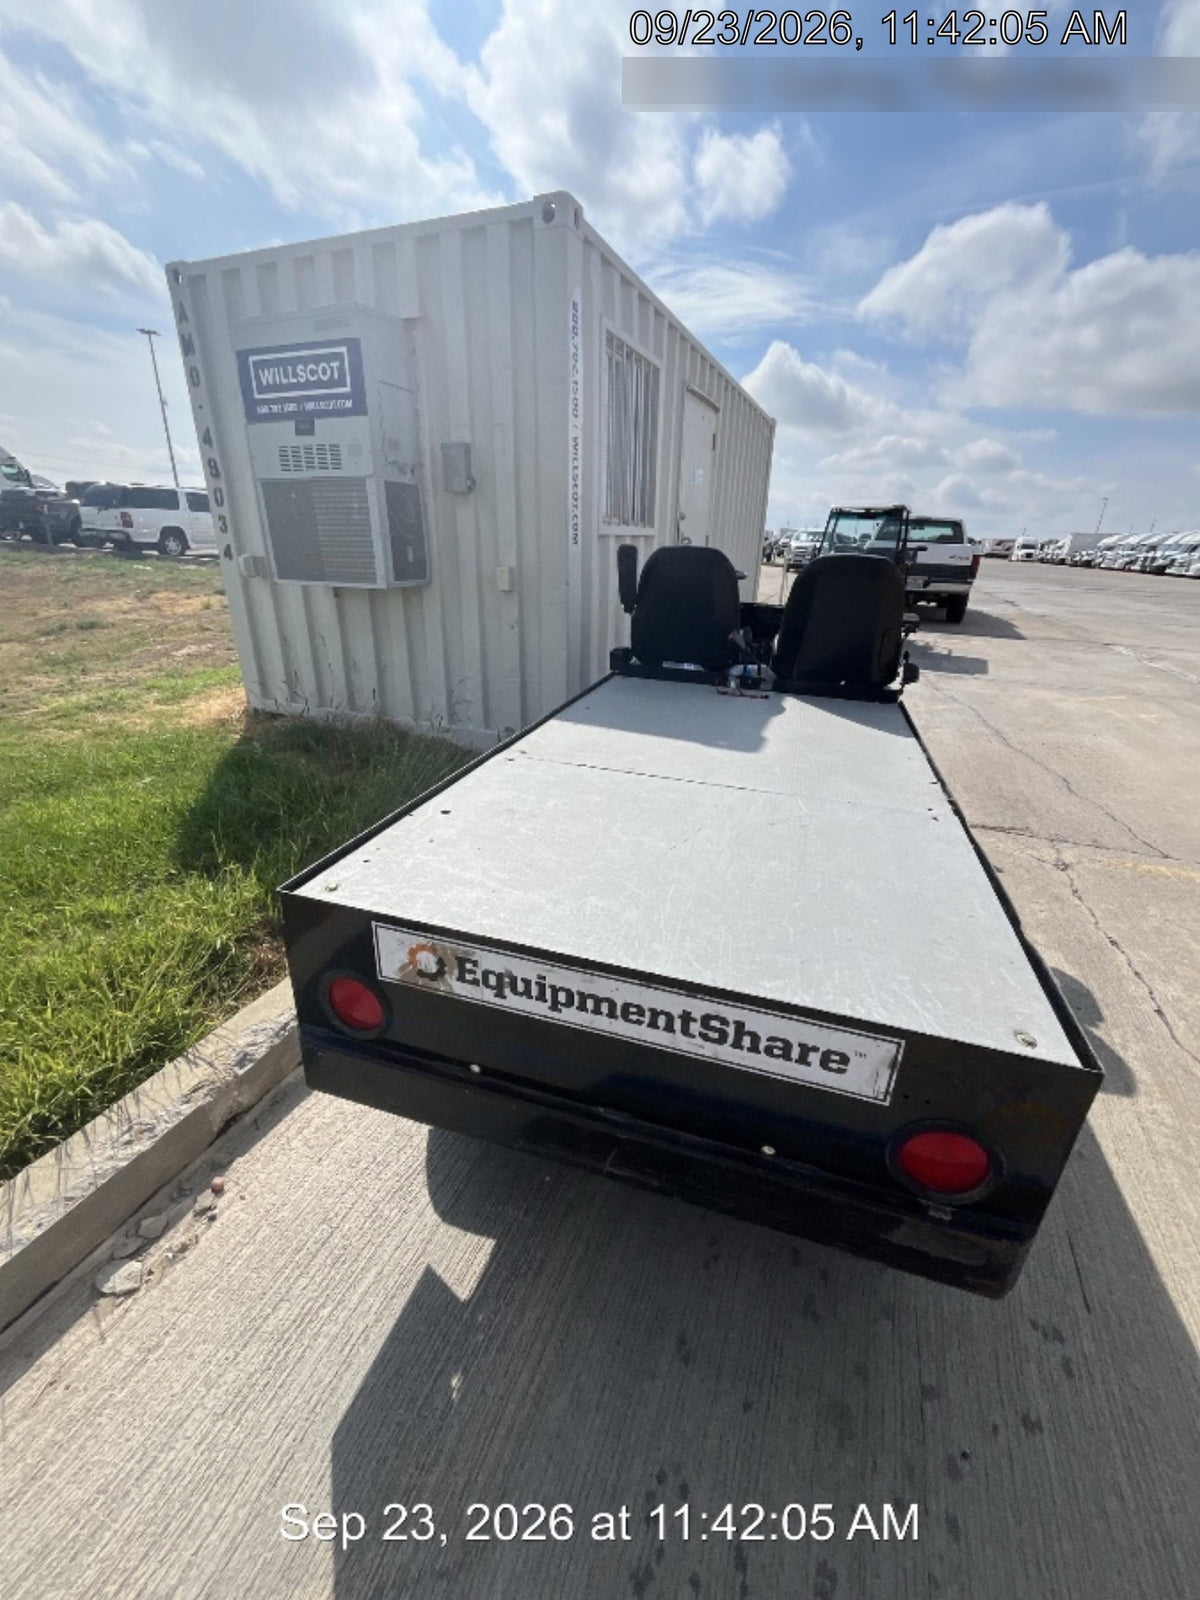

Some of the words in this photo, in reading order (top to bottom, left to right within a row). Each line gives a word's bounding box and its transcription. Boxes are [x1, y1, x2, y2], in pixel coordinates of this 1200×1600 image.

[258, 361, 340, 387] WILLSCOT
[571, 436, 579, 545] WILLSCOT.COM
[455, 956, 850, 1075] EquipmentShare
